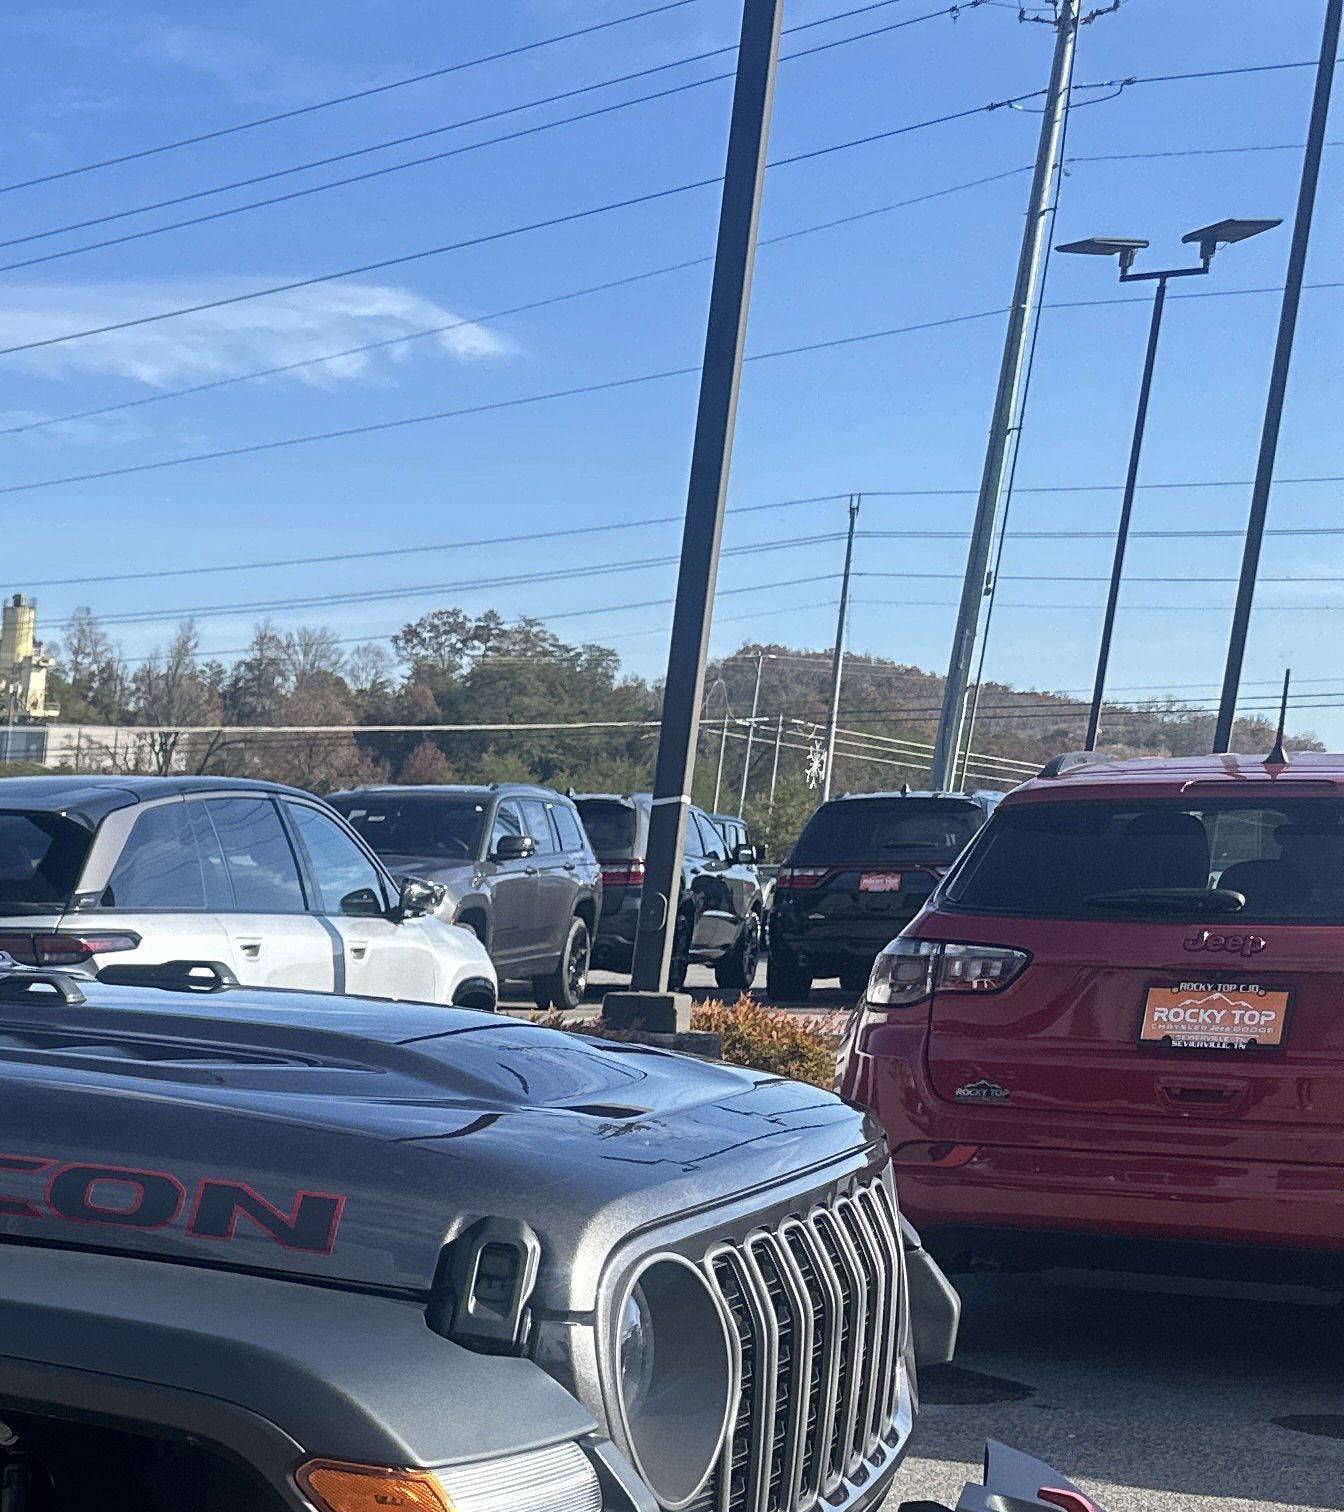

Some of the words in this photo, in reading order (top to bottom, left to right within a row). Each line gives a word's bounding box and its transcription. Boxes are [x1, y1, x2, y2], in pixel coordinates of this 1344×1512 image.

[1183, 929, 1267, 958] Jeep
[1179, 982, 1214, 992] ROCKY
[1217, 983, 1237, 993] TOP
[1153, 1007, 1228, 1024] ROCKY
[1231, 1010, 1277, 1025] TOP
